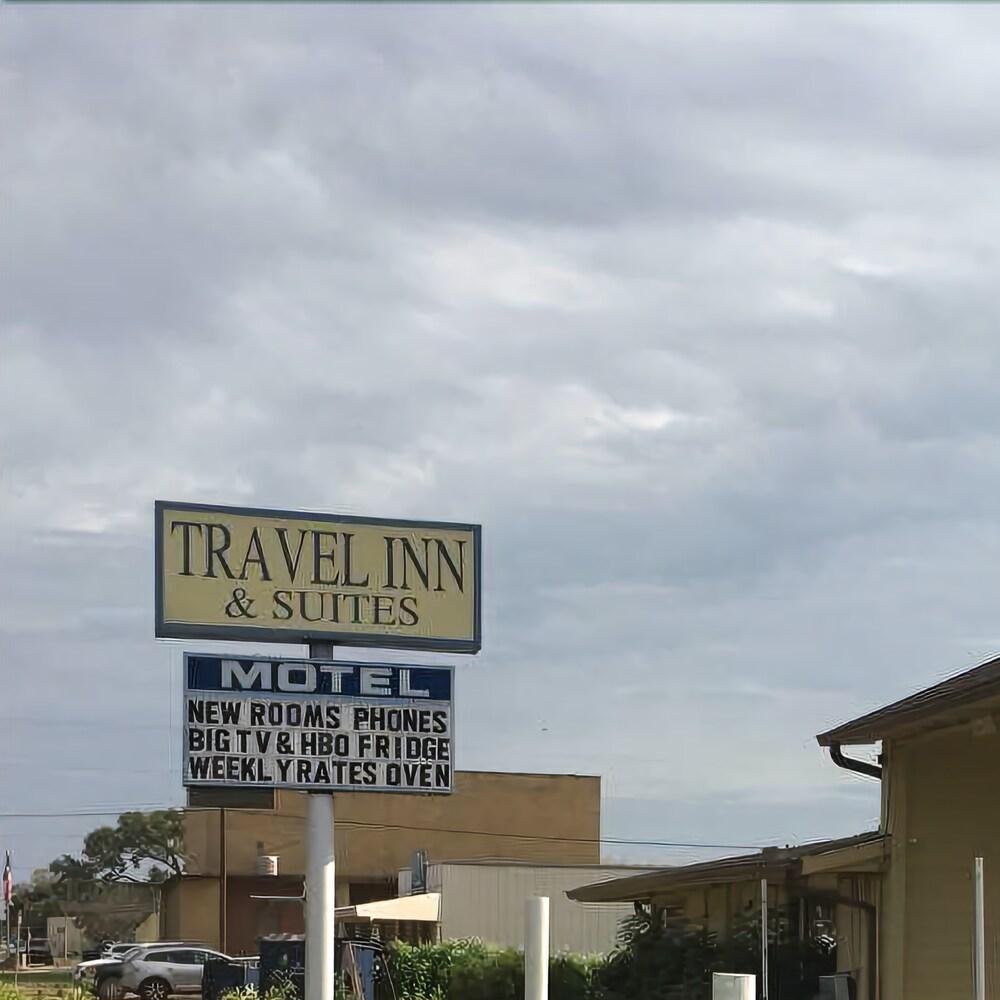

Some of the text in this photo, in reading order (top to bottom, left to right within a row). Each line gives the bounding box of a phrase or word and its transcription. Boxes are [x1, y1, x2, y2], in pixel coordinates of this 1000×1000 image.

[171, 521, 467, 593] TRAVEL INN
[225, 587, 419, 626] & SUITES
[220, 659, 430, 698] MOTEL
[188, 699, 447, 734] NEW ROOMS PHONES
[188, 728, 450, 761] BIG TV & HBO FRIDGE
[189, 756, 450, 788] WEEKLY RATES OVEN
